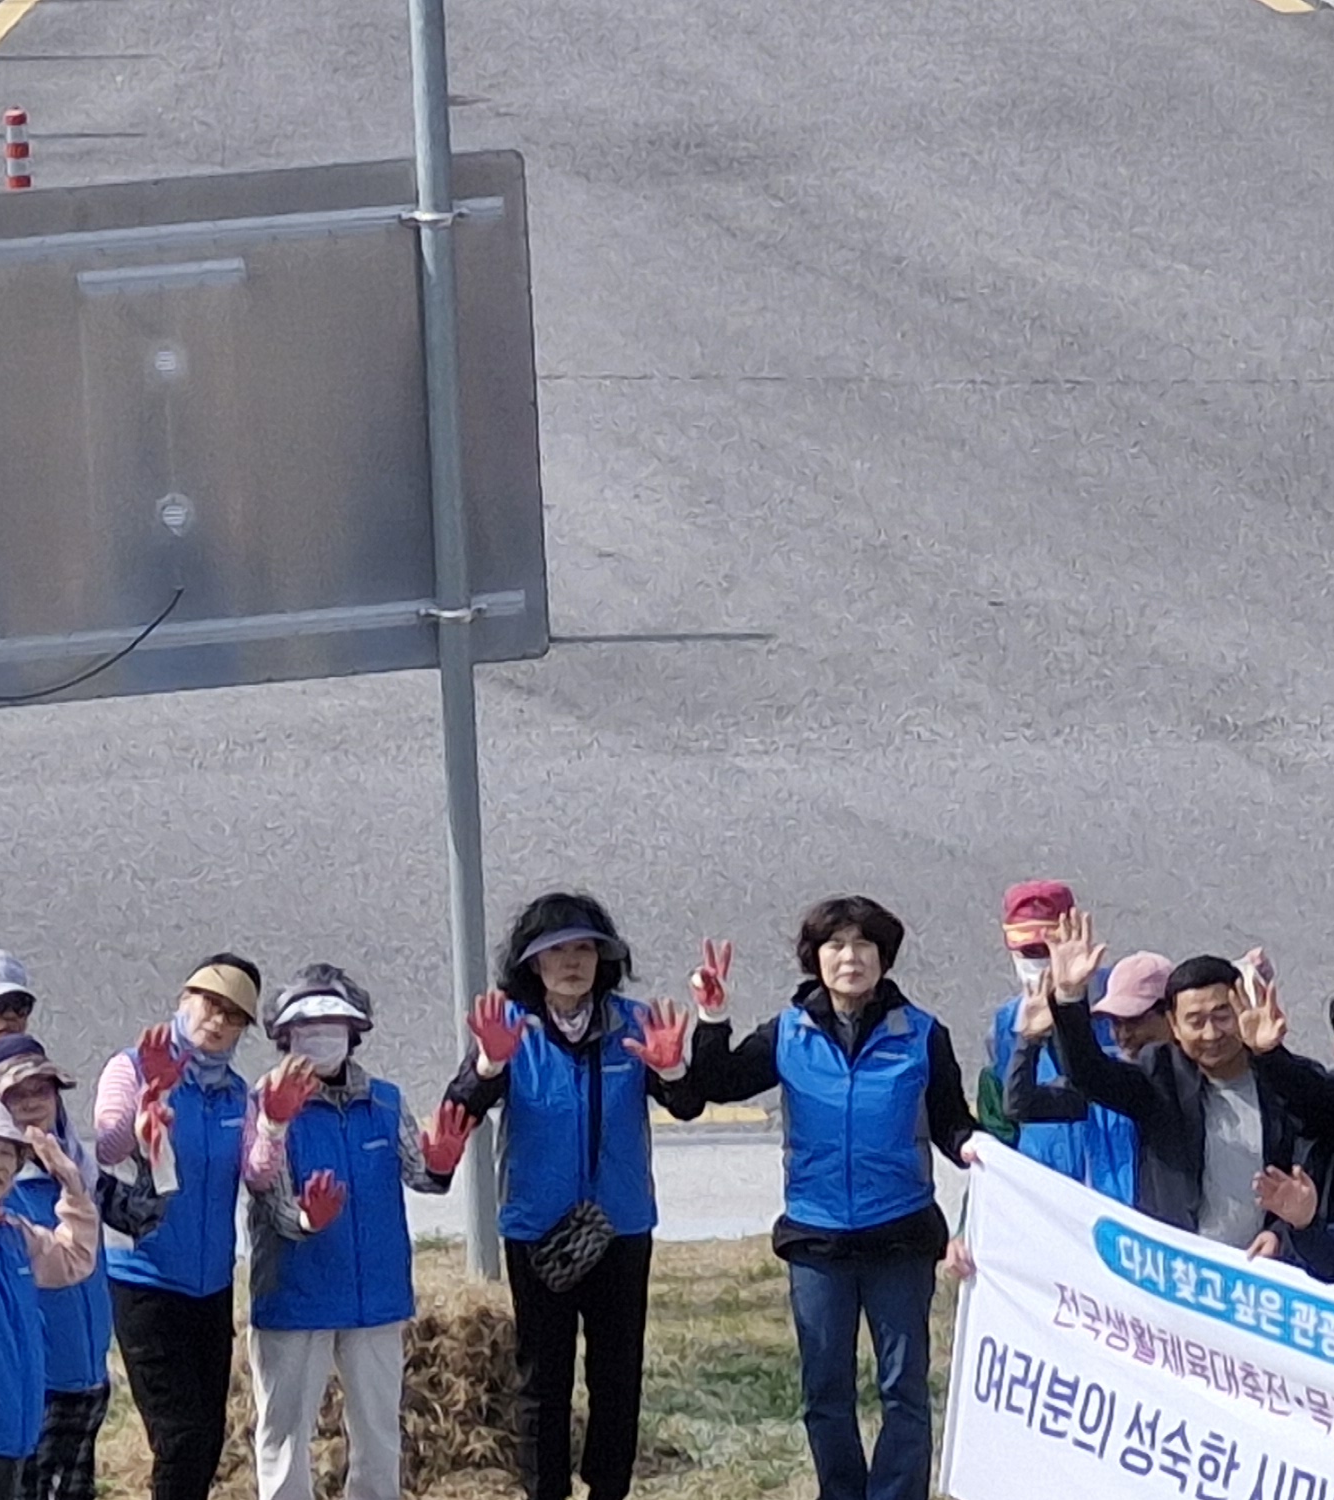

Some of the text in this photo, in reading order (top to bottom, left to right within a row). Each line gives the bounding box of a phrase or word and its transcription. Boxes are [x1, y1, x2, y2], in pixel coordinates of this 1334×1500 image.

[1117, 1235, 1166, 1292] 다시
[1171, 1258, 1226, 1311] 찾고
[1230, 1279, 1285, 1337] 싶은
[974, 1335, 1117, 1460] 여러분의
